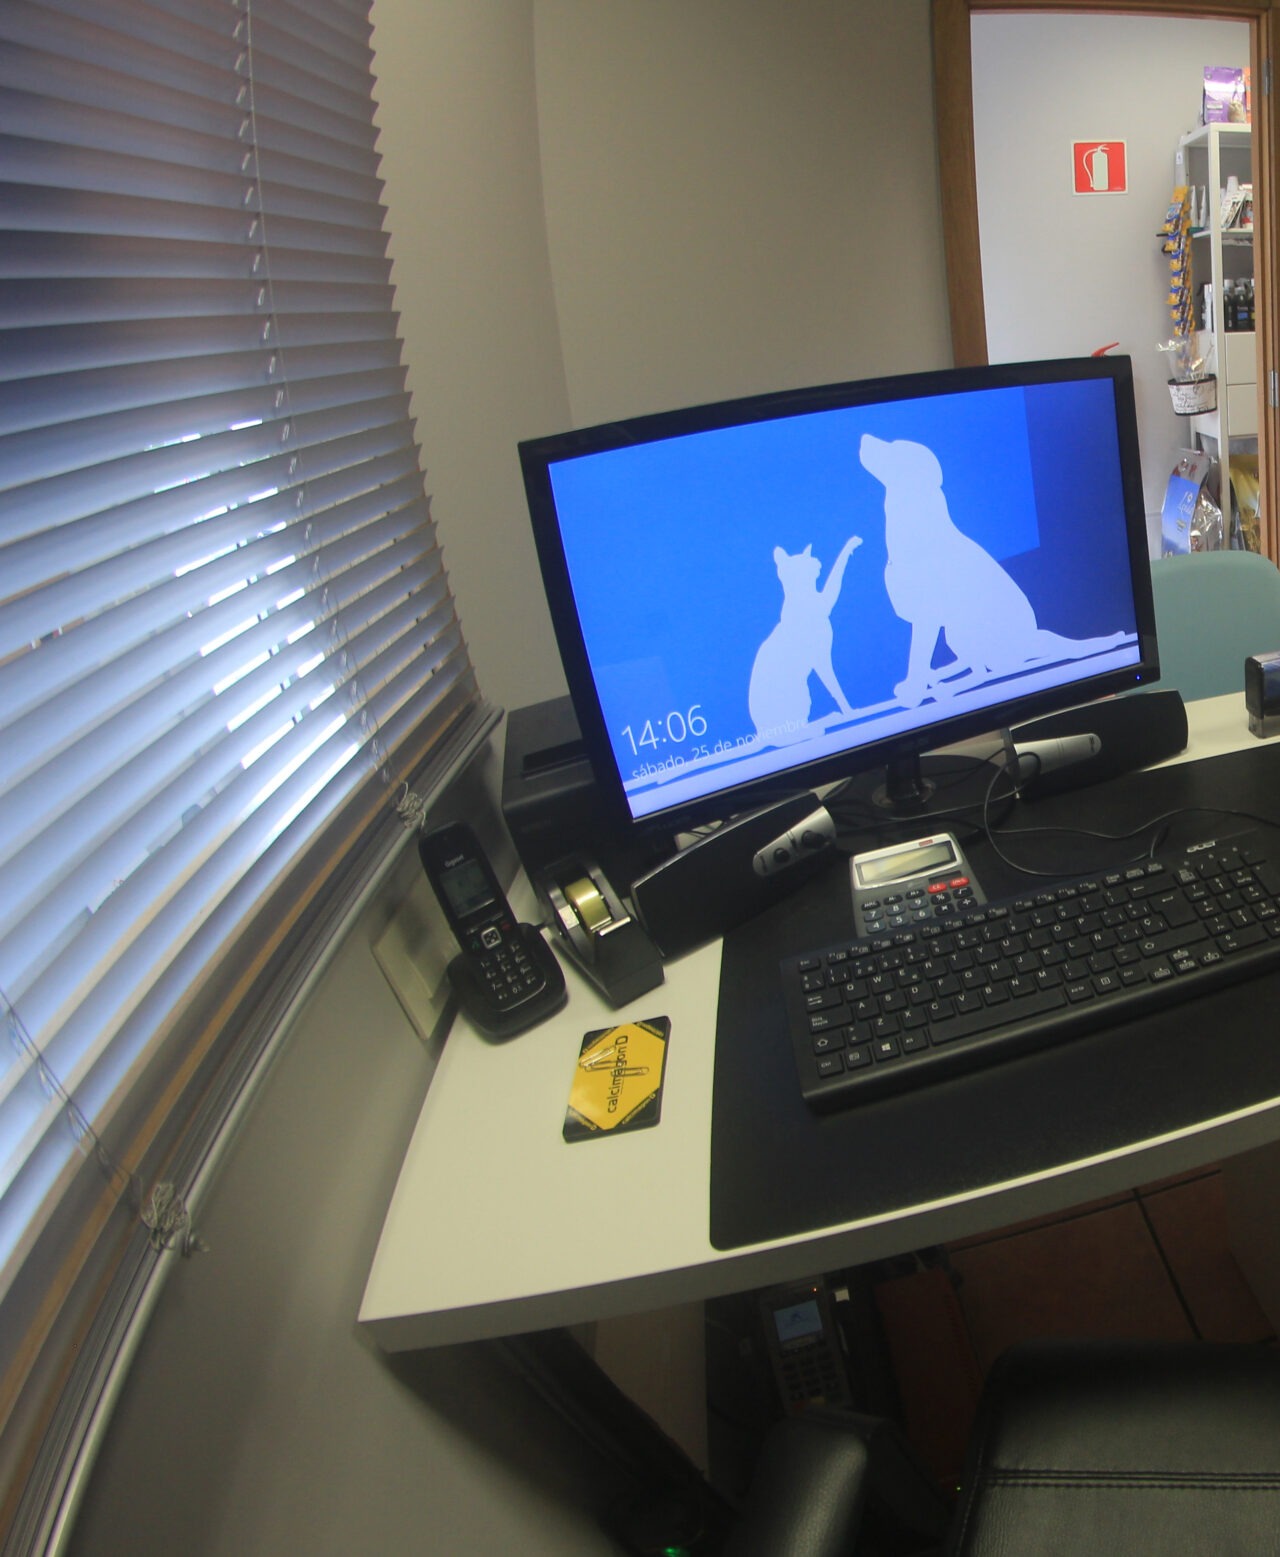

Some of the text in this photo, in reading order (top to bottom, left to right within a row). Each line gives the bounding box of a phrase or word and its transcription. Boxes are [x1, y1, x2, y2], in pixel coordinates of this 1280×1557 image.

[621, 704, 708, 756] 14:06
[632, 754, 689, 781] sábado,
[691, 744, 710, 760] 25
[714, 739, 733, 754] de
[615, 1035, 629, 1046] D
